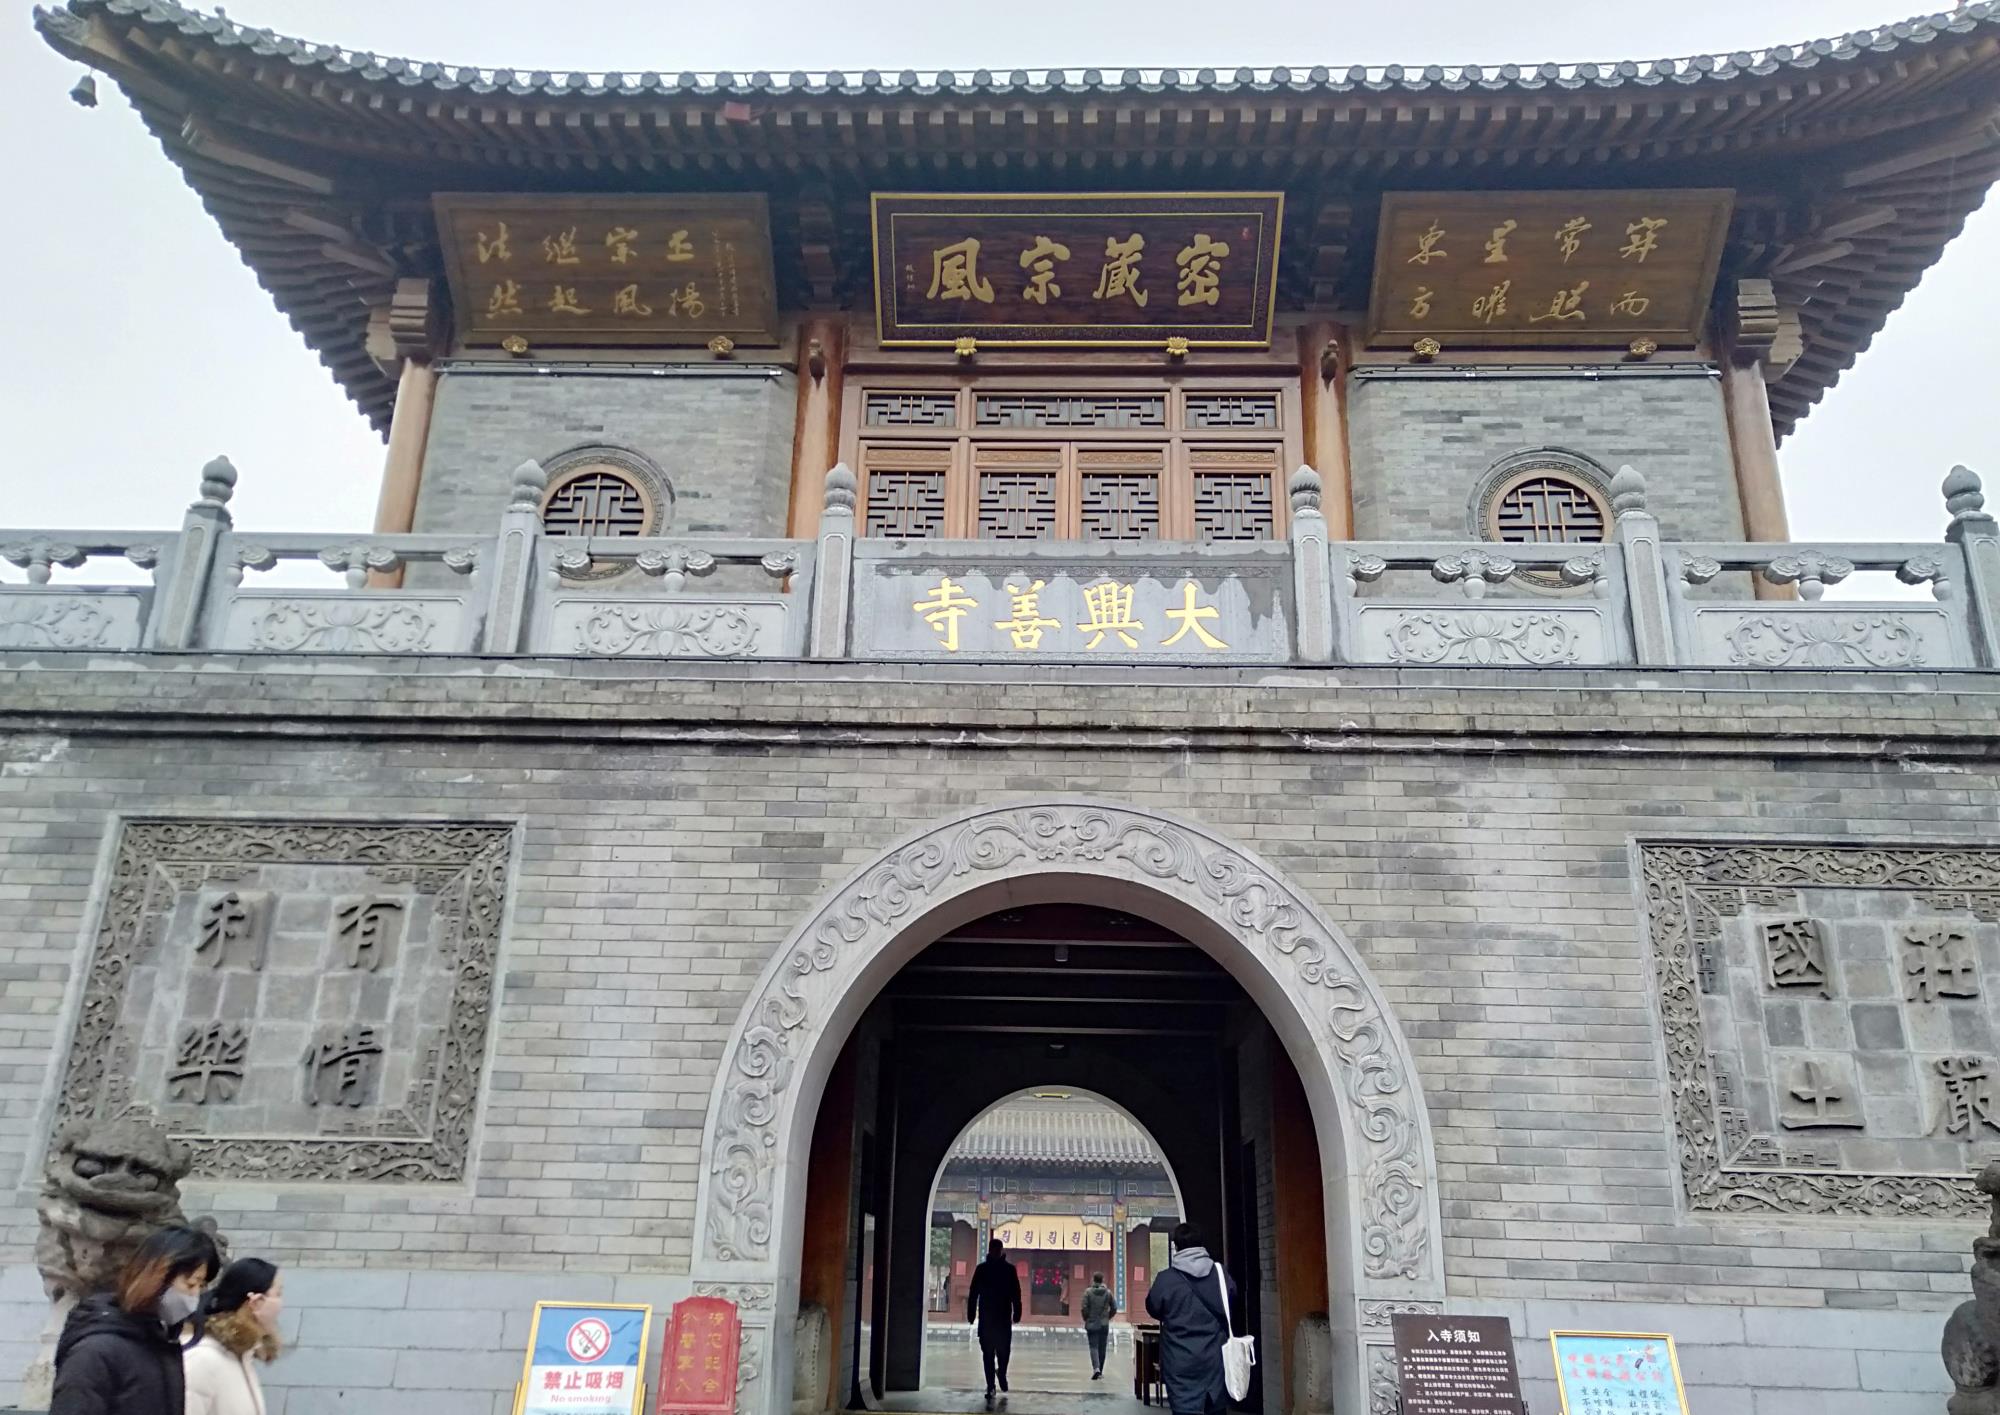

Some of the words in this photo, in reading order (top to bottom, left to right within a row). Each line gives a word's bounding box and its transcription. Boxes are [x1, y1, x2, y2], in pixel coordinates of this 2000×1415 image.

[913, 576, 1230, 652] 大興善寺
[1427, 1329, 1480, 1343] 入寺须知
[544, 1371, 624, 1390] 禁止吸烟
[550, 1394, 565, 1403] No
[568, 1394, 612, 1404] smoking
